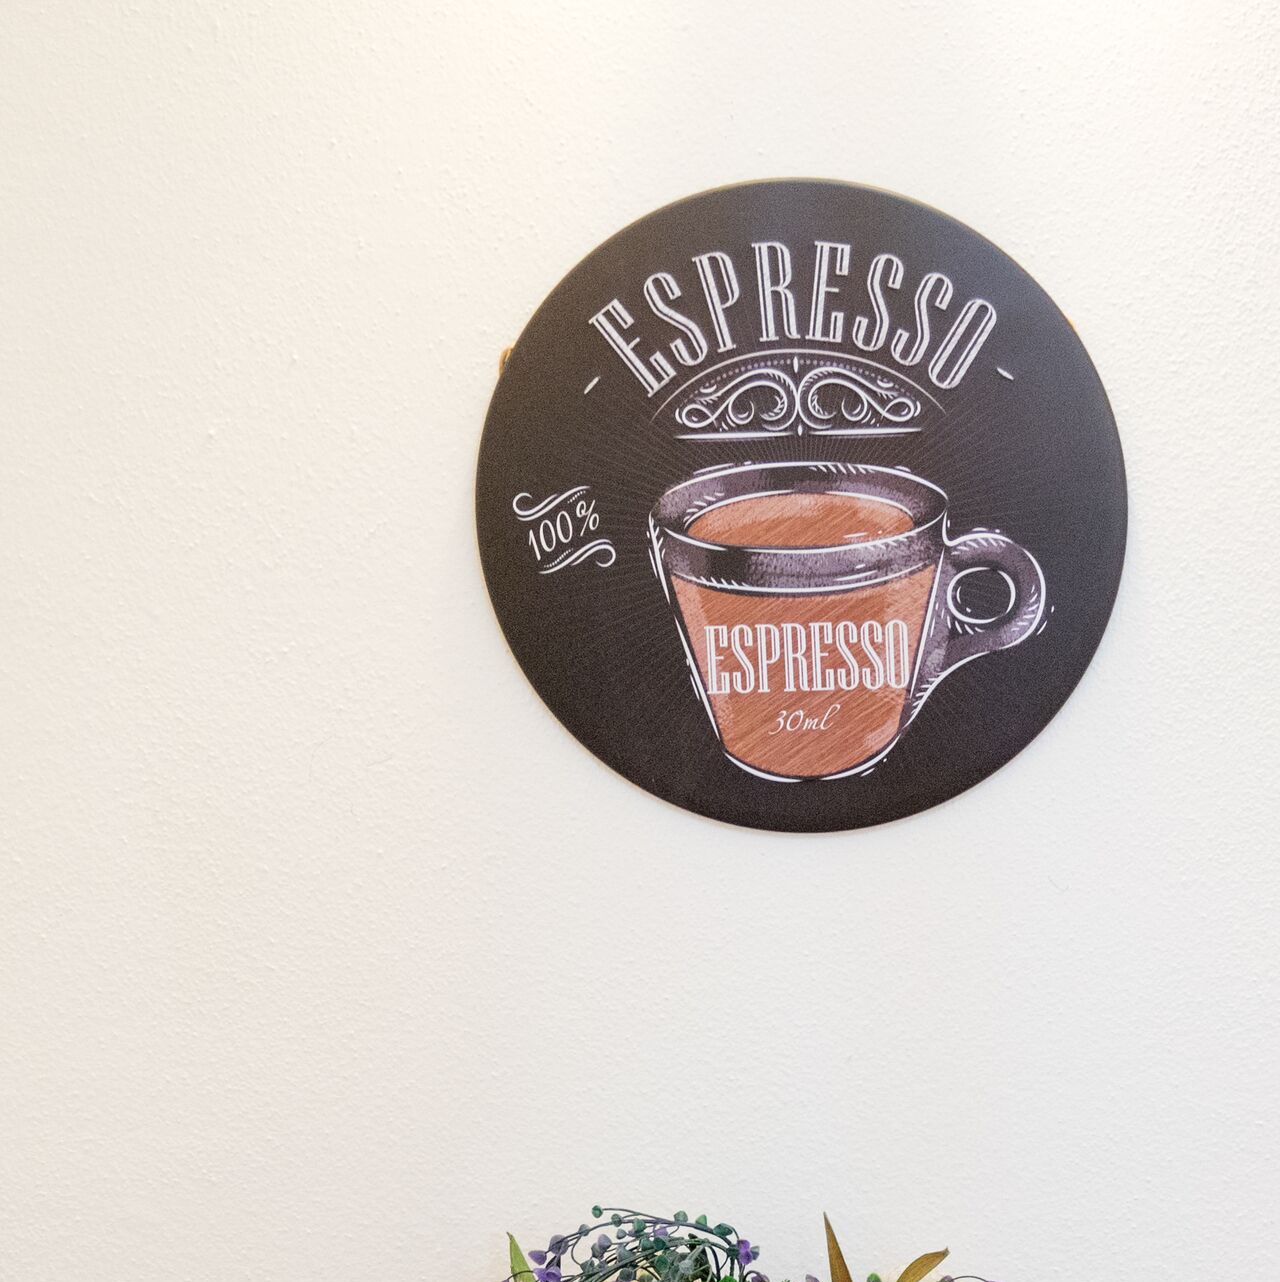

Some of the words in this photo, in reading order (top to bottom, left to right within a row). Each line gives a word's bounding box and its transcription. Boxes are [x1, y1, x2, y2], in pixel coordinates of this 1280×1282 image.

[588, 240, 997, 397] ESPRESSO
[527, 500, 600, 561] 100%
[704, 619, 910, 695] ESPRESSO
